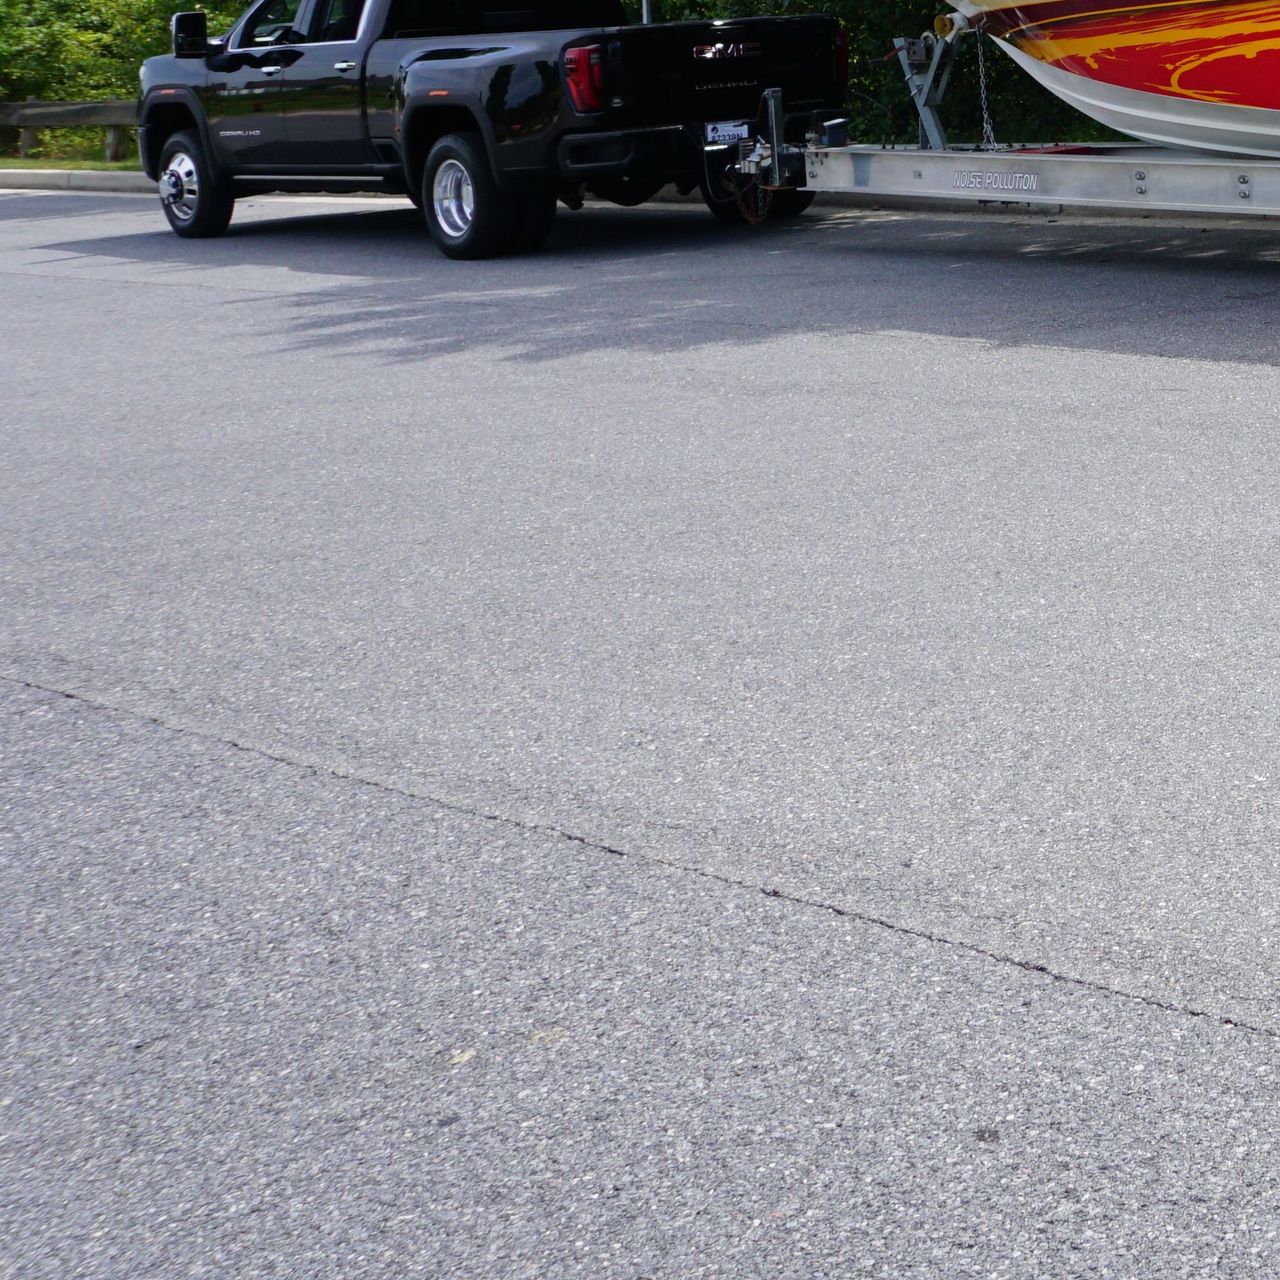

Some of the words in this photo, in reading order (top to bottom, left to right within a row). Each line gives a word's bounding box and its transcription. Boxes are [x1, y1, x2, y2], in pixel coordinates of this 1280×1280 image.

[693, 43, 761, 58] GMC
[953, 170, 983, 188] NOISE
[985, 172, 1037, 190] POLLUTION
